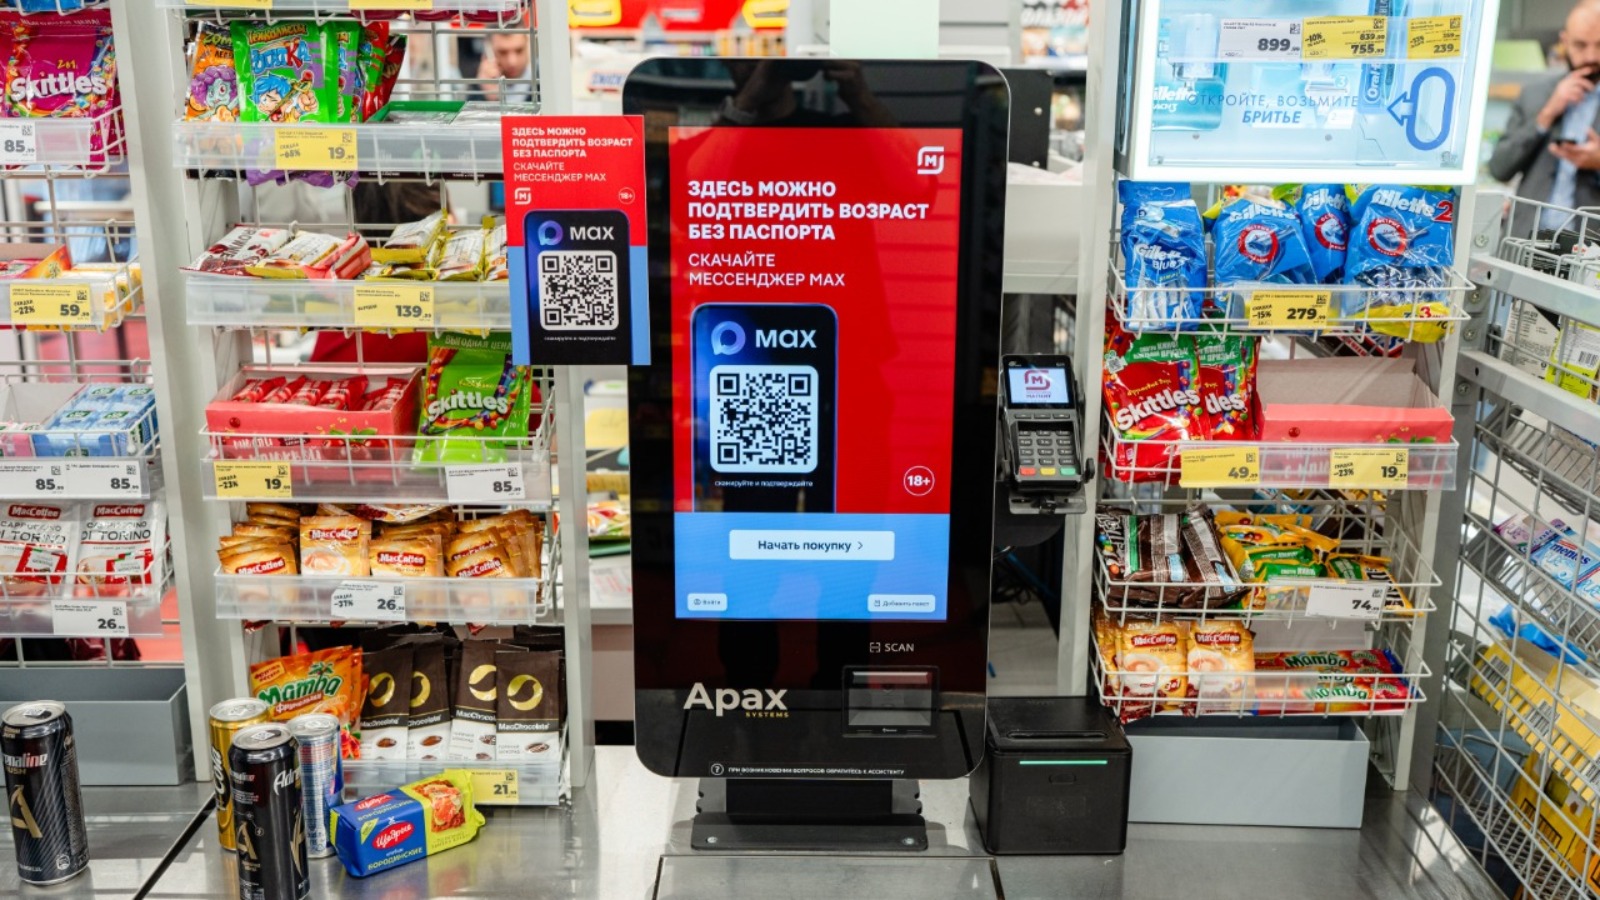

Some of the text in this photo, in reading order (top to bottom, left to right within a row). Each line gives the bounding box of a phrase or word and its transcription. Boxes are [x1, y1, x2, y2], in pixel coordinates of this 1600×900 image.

[1277, 95, 1358, 107] ВОЗЬМИТЕ
[1242, 110, 1301, 124] БРИТЬЕ
[511, 127, 586, 137] ЗДЕСЬ МОЖНО
[512, 138, 633, 148] ПОДТВЕРДИТЬ ВОЗРАСТ
[512, 149, 587, 158] БЕЗ ПАСПОРТА
[513, 160, 565, 171] СКАЧАЙТЕ
[513, 172, 607, 182] МЕССЕНДЖЕР MAX
[687, 180, 837, 198] ЗДЕСЬ МОЖНО
[620, 192, 634, 200] 18+
[688, 202, 929, 220] ПОДТВЕРДИТЬ ВОЗРАСТ
[688, 224, 836, 240] БЕЗ ПАСПОРТА
[688, 250, 776, 267] СКАЧАЙТЕ
[689, 271, 846, 288] МЕССЕНДЖЕР MAX
[445, 335, 489, 348] ВЫГОДНАЯ
[906, 475, 931, 486] 18+
[757, 540, 852, 553] Начать покупку
[884, 643, 914, 652] SCAN
[683, 682, 788, 717] Apax
